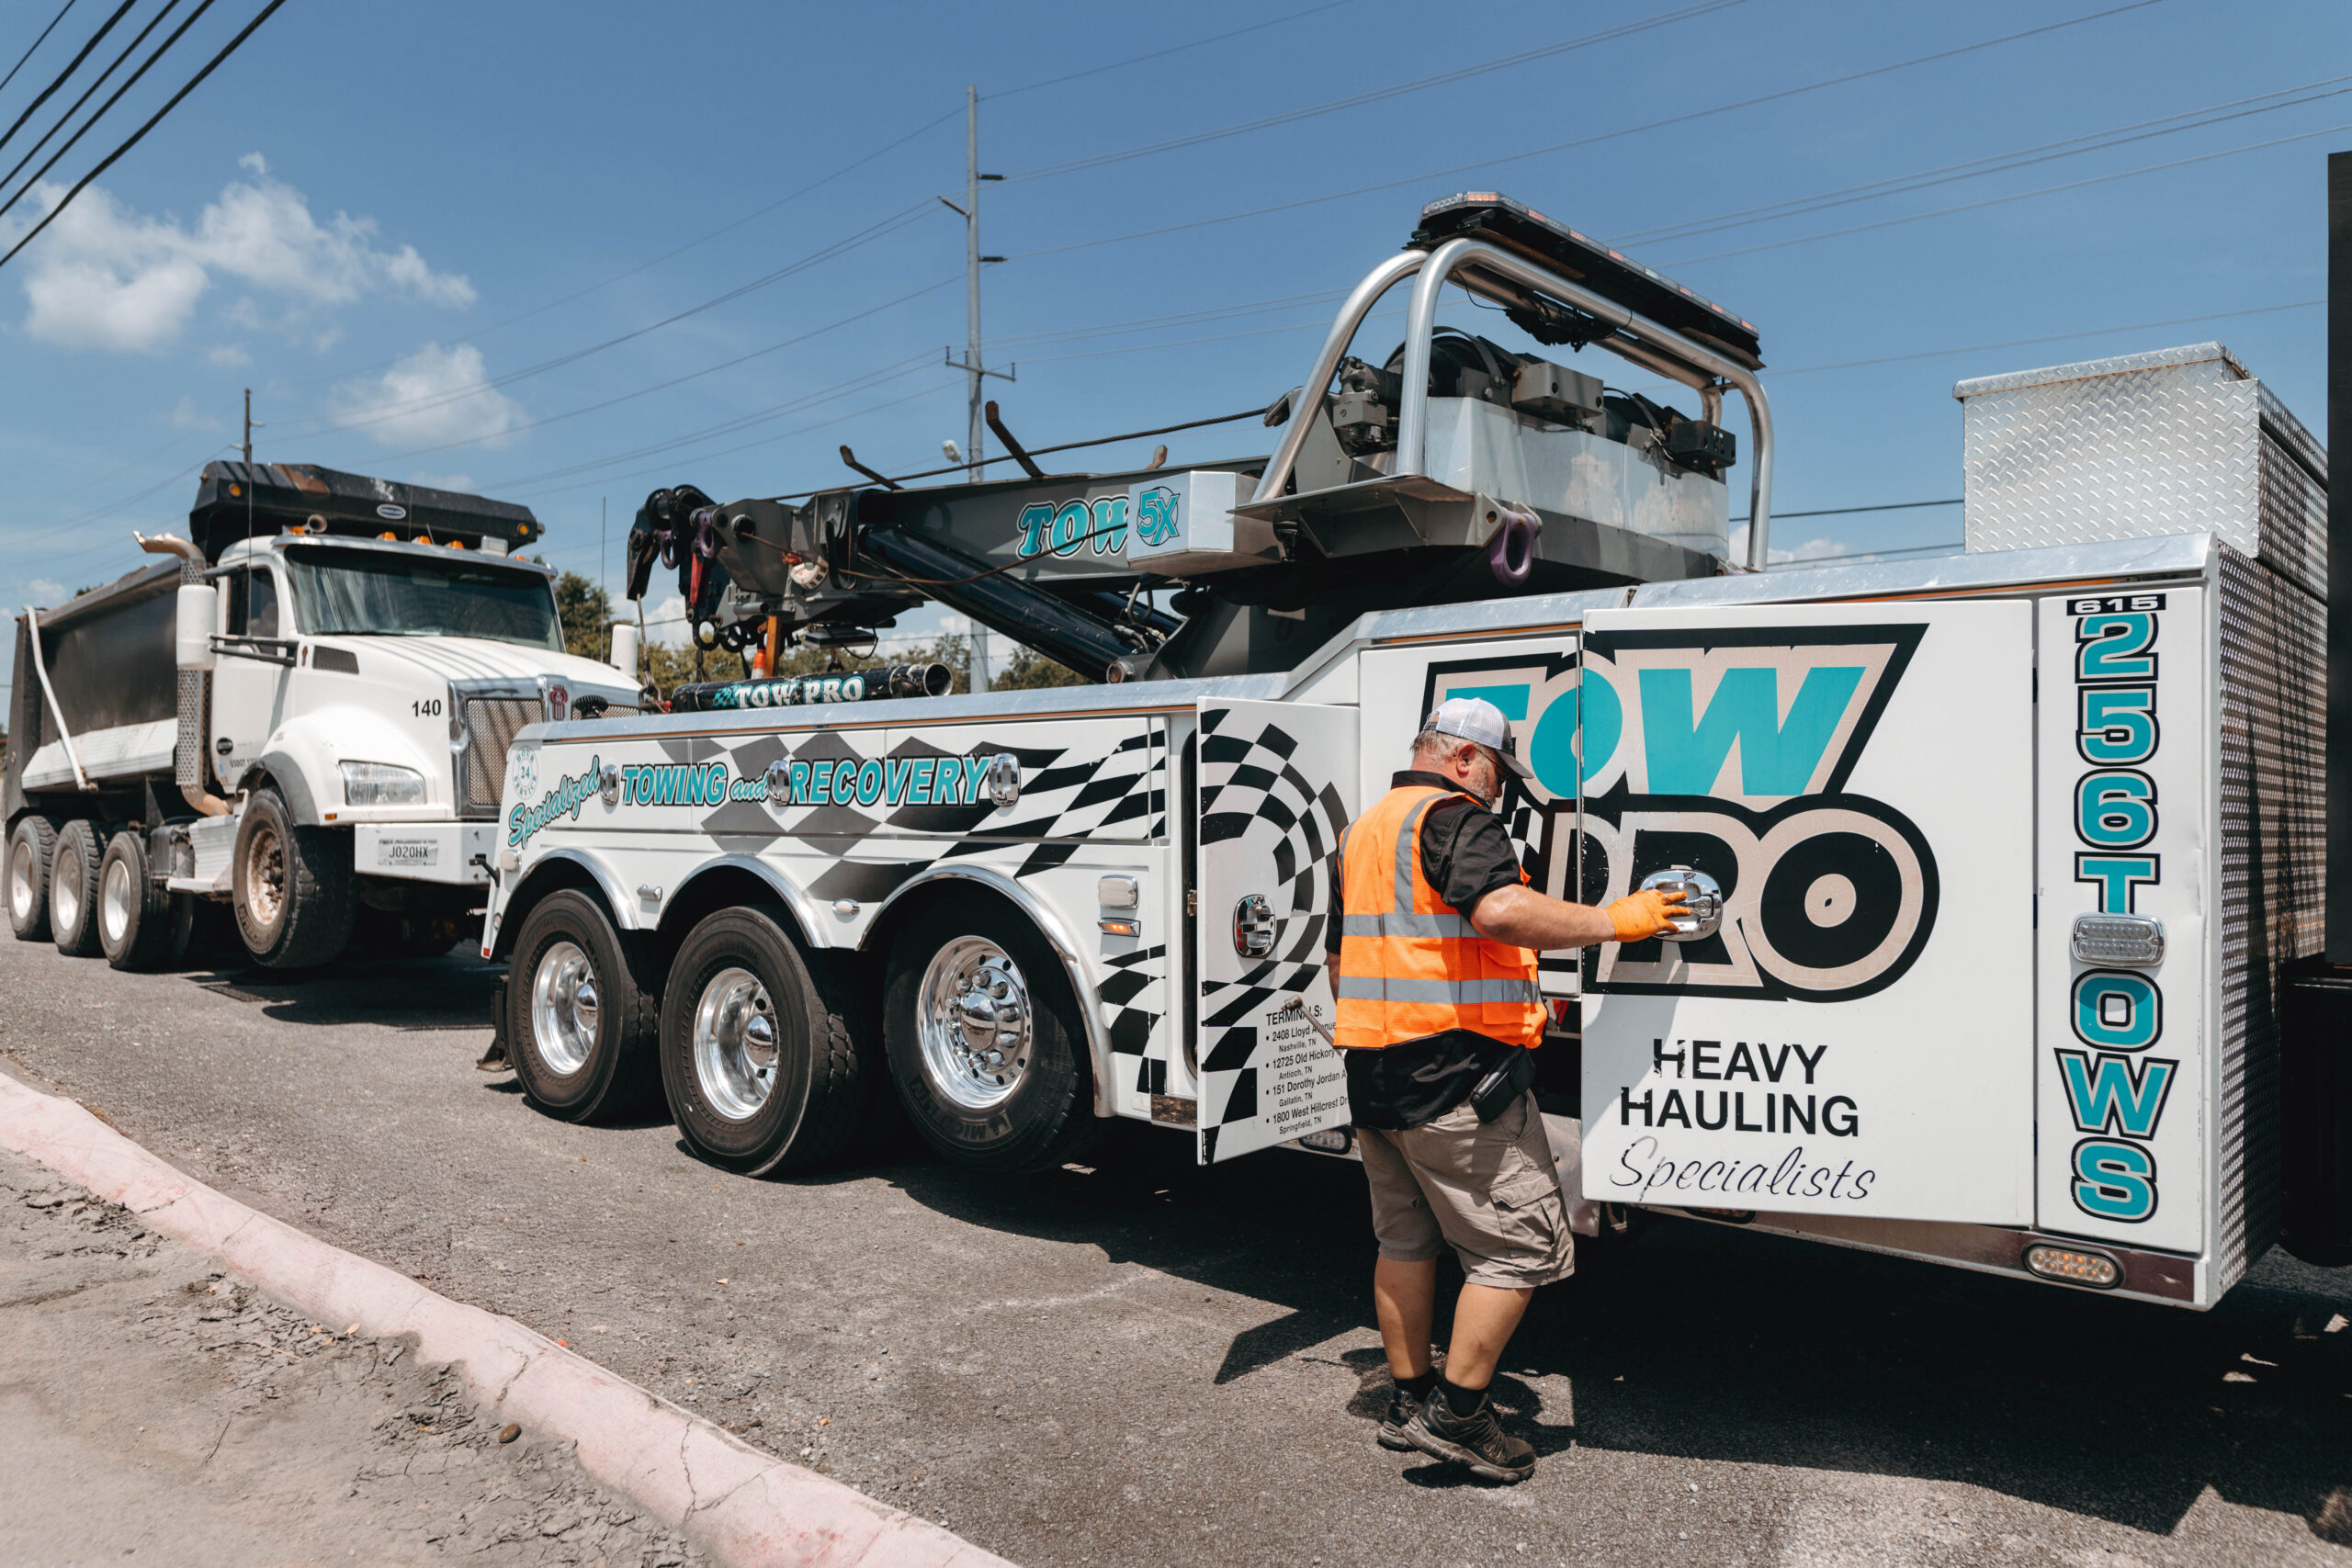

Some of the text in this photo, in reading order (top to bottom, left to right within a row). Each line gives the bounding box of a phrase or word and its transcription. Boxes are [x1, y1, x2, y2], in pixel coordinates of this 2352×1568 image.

[1016, 493, 1129, 559] TOW
[1136, 489, 1181, 545] 5X
[2074, 595, 2159, 615] 615
[735, 676, 865, 709] TOW PRO
[413, 699, 441, 717] 140
[516, 749, 535, 762] HOUR
[521, 766, 530, 779] 24
[514, 776, 537, 796] SERVICE
[508, 754, 993, 850] Specialized TOWING and RECOVERY
[1291, 1024, 1310, 1037] Lloyd
[1279, 1038, 1317, 1053] Nashville, TN
[1272, 1048, 1335, 1069] 12725 Old Hickory
[1654, 1038, 1828, 1085] HEAVY
[1272, 1084, 1284, 1095] 151
[1287, 1077, 1315, 1092] Dorothy
[1317, 1071, 1340, 1085] Jordan
[1279, 1066, 1313, 1080] Antioch, TN
[1279, 1091, 1313, 1107] Gallatin, TN
[1272, 1111, 1290, 1123] 1800
[1291, 1106, 1309, 1119] West
[1311, 1098, 1338, 1114] Hillcrest
[1620, 1087, 1859, 1137] HAULING
[1279, 1116, 1322, 1134] Springfield, TN
[1609, 1135, 1875, 1201] Specialists
